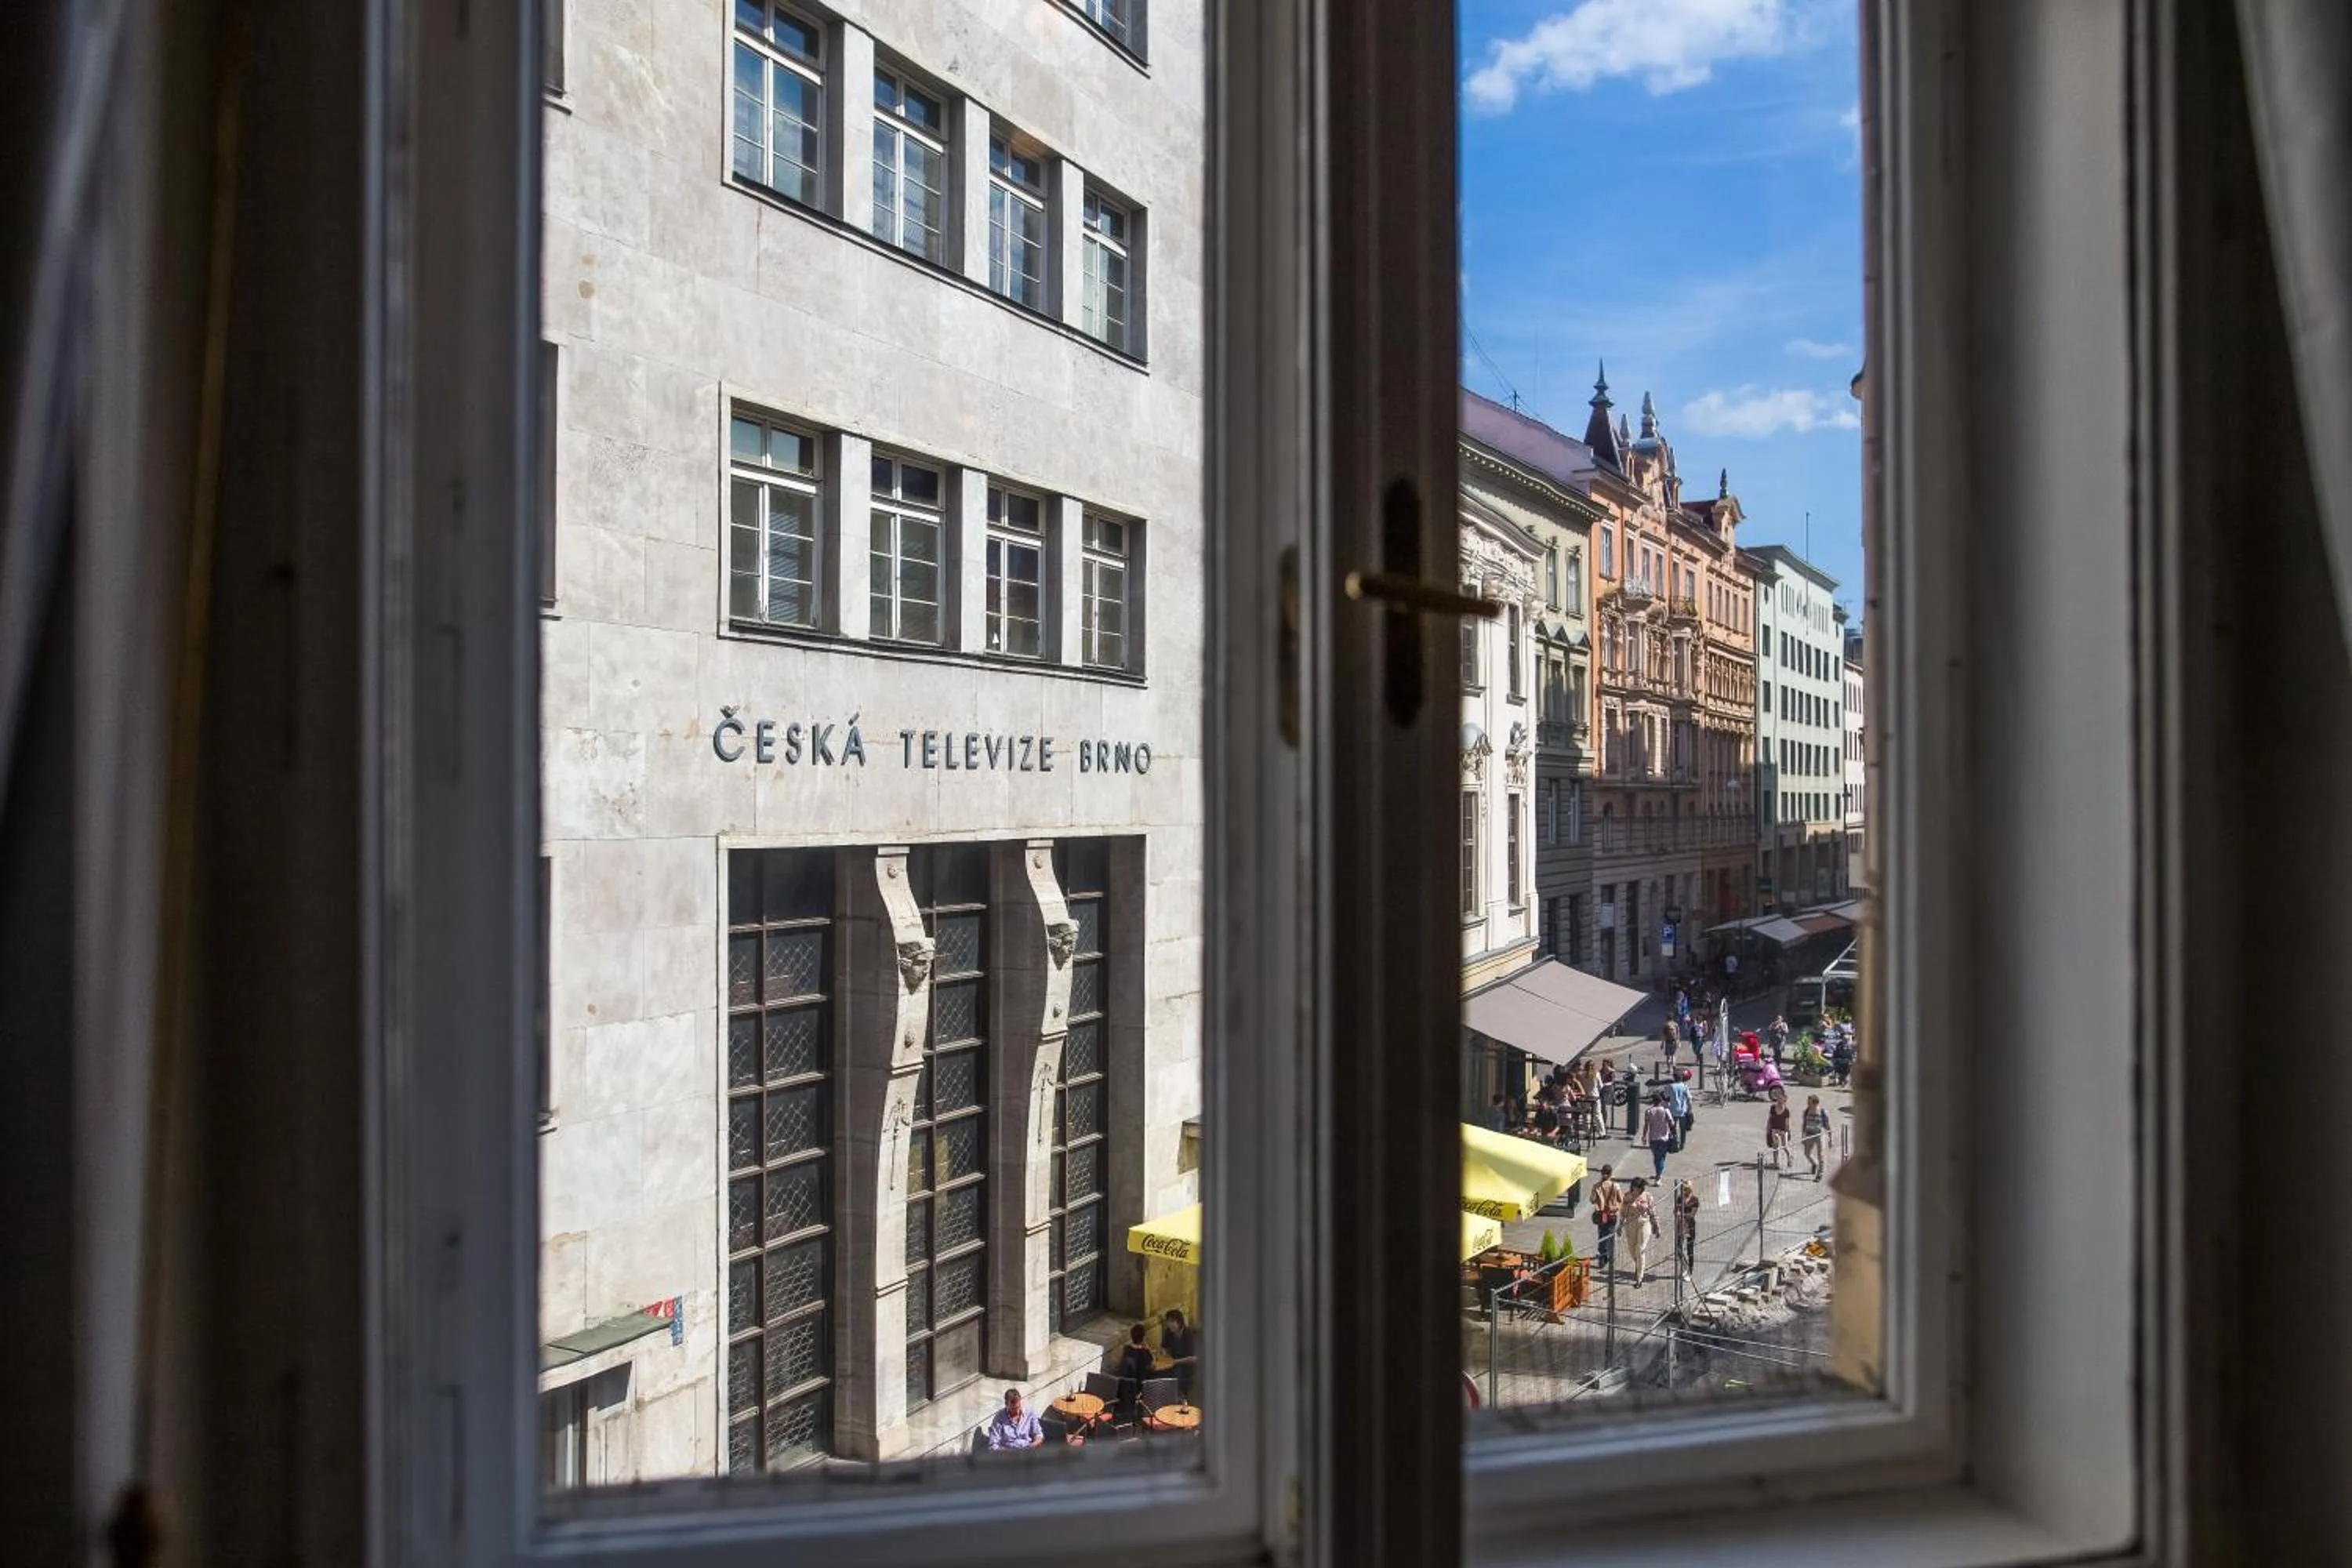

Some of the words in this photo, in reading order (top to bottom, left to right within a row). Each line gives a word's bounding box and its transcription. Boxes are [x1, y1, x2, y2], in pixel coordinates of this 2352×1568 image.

[713, 706, 866, 766] ČESKÁ
[900, 729, 1054, 772] TELEVIZE
[1080, 739, 1152, 775] BRNO
